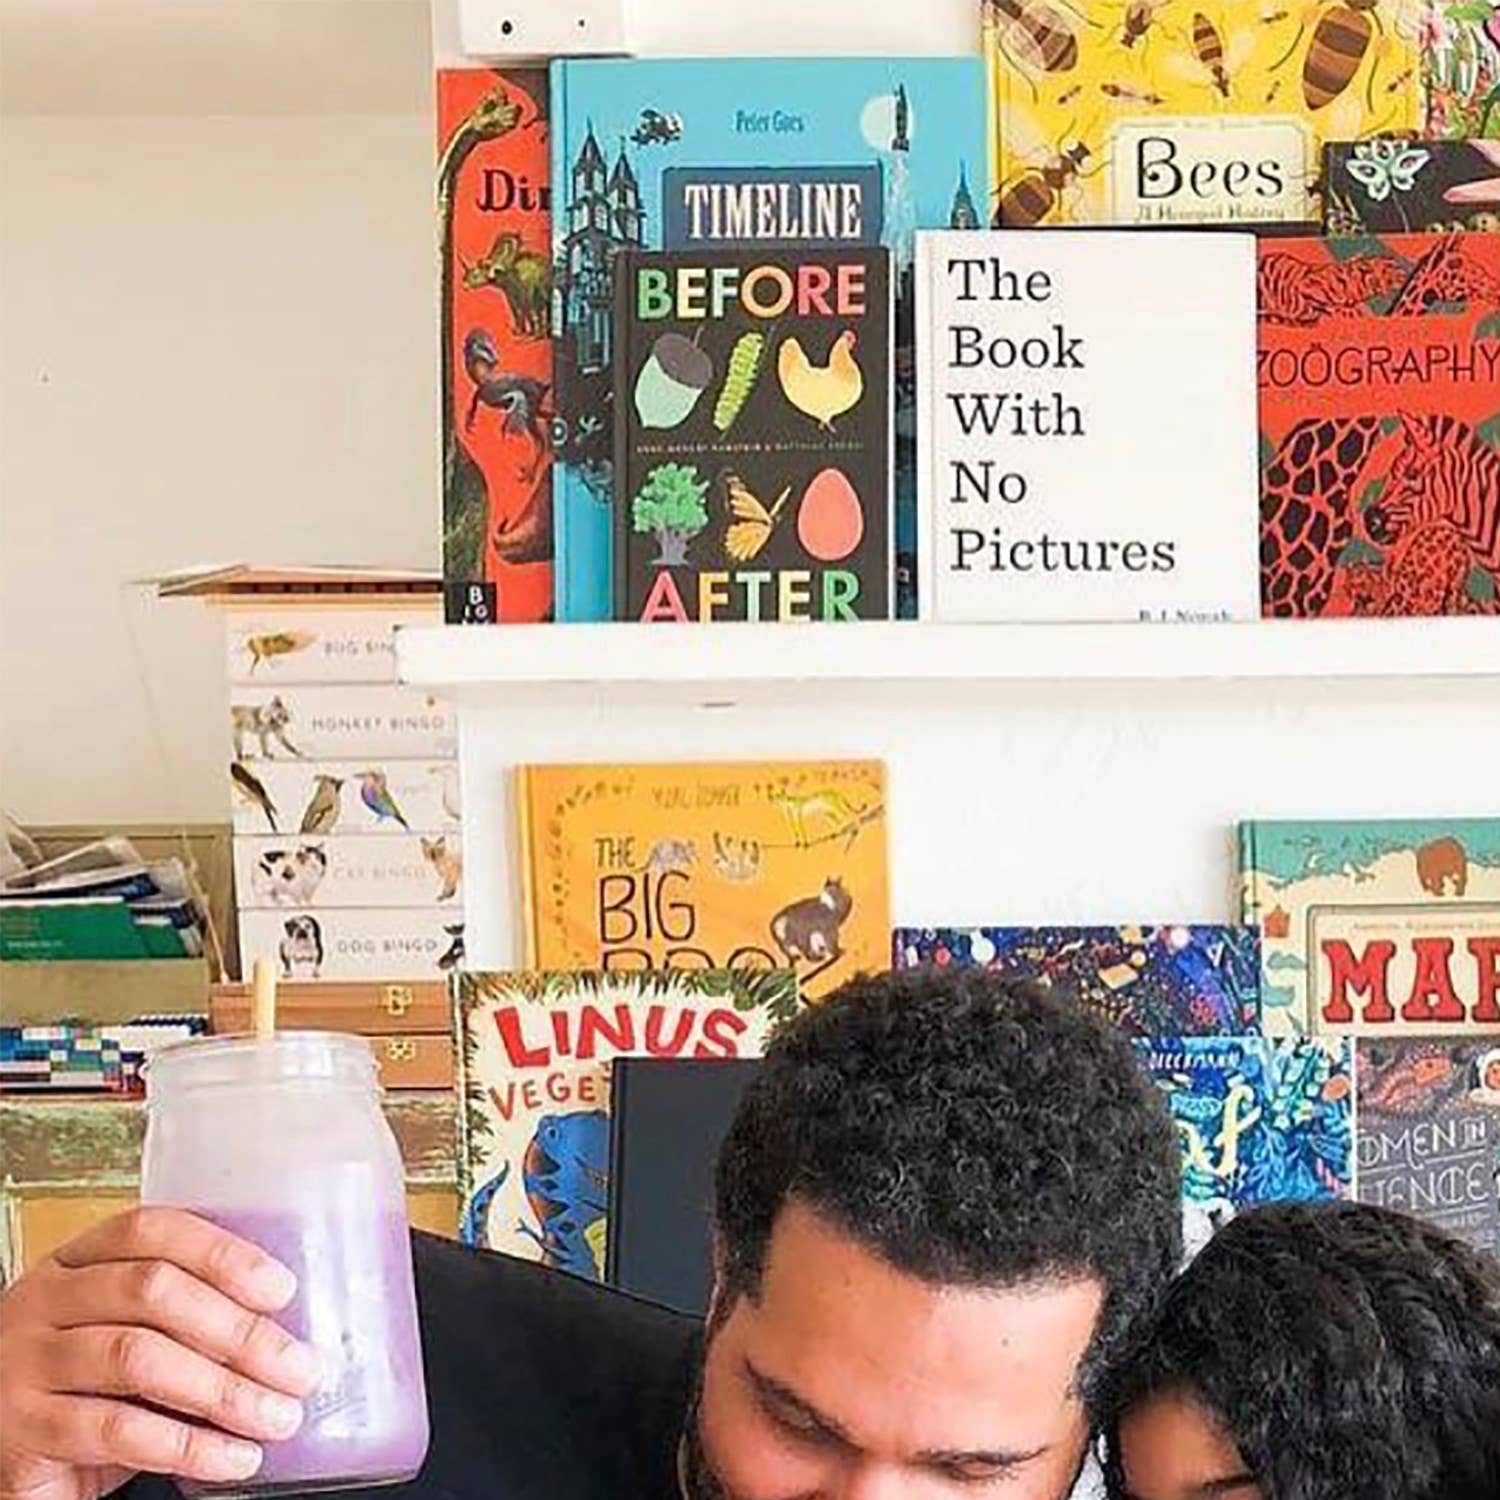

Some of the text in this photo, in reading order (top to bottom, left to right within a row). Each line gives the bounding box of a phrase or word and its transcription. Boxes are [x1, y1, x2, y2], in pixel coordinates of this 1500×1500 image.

[1138, 136, 1284, 199] Bees
[684, 182, 863, 239] TIMELINE
[637, 264, 867, 320] BEFORE
[947, 257, 1052, 302] The
[948, 325, 1085, 369] Book
[946, 392, 1085, 436] With
[950, 460, 1028, 504] No
[950, 527, 1176, 573] Pictures
[640, 569, 862, 625] AFTER
[390, 715, 445, 731] BINGO
[595, 836, 636, 868] THE
[598, 870, 696, 944] BIG
[337, 937, 439, 954] DOG BINGO
[493, 1003, 748, 1069] LINUS
